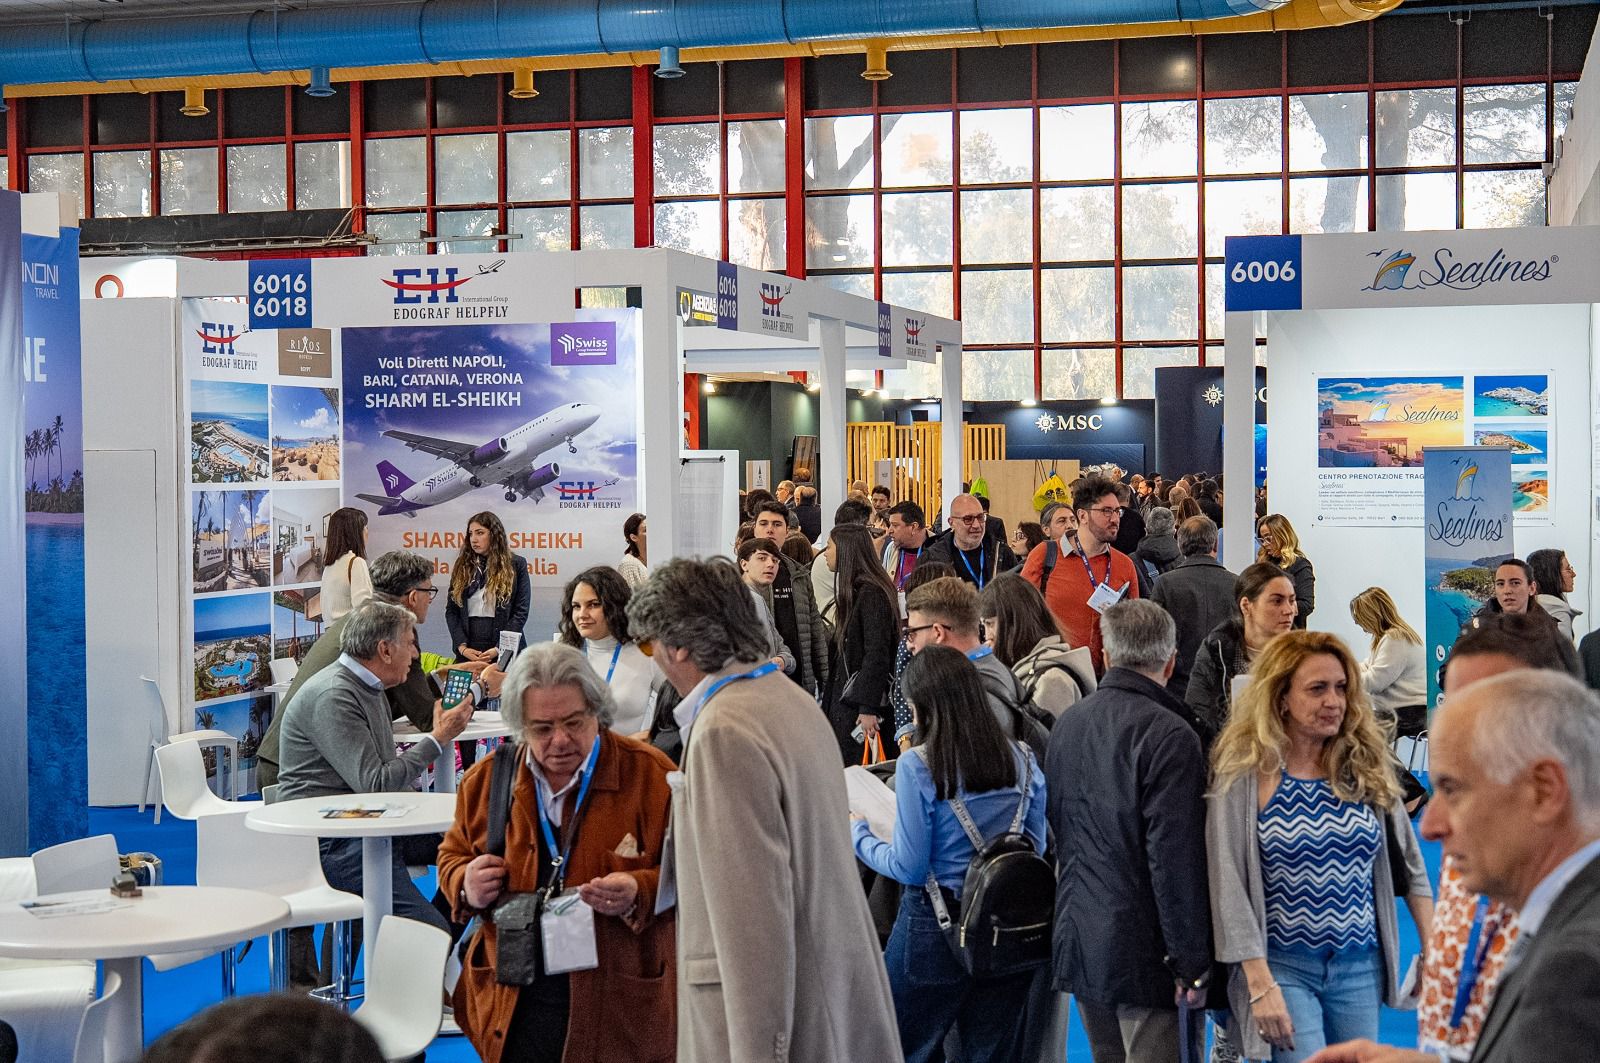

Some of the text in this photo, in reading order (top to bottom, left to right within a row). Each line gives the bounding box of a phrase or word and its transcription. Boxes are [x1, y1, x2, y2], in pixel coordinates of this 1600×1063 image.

[1231, 260, 1296, 284] 6006
[35, 287, 59, 299] TRAVEL
[253, 274, 307, 295] 6016
[719, 275, 737, 297] 6016
[253, 297, 307, 317] 6018
[394, 306, 509, 320] EDOGRAF HELPFLY
[719, 298, 737, 319] 6018
[290, 335, 321, 353] RIXOS
[575, 337, 608, 348] Swiss
[203, 356, 258, 371] EDOGRAF HELPFLY
[378, 355, 506, 369] Voli Diretti NAPOLI,
[363, 372, 524, 389] BARI, CATANIA, VERONA
[365, 391, 521, 409] SHARM EL-SHEIKH
[1399, 403, 1460, 424] Sealines
[1057, 415, 1103, 431] MSC
[559, 501, 622, 509] EDOGRAF HELPFLY
[509, 532, 583, 549] SHEIKH
